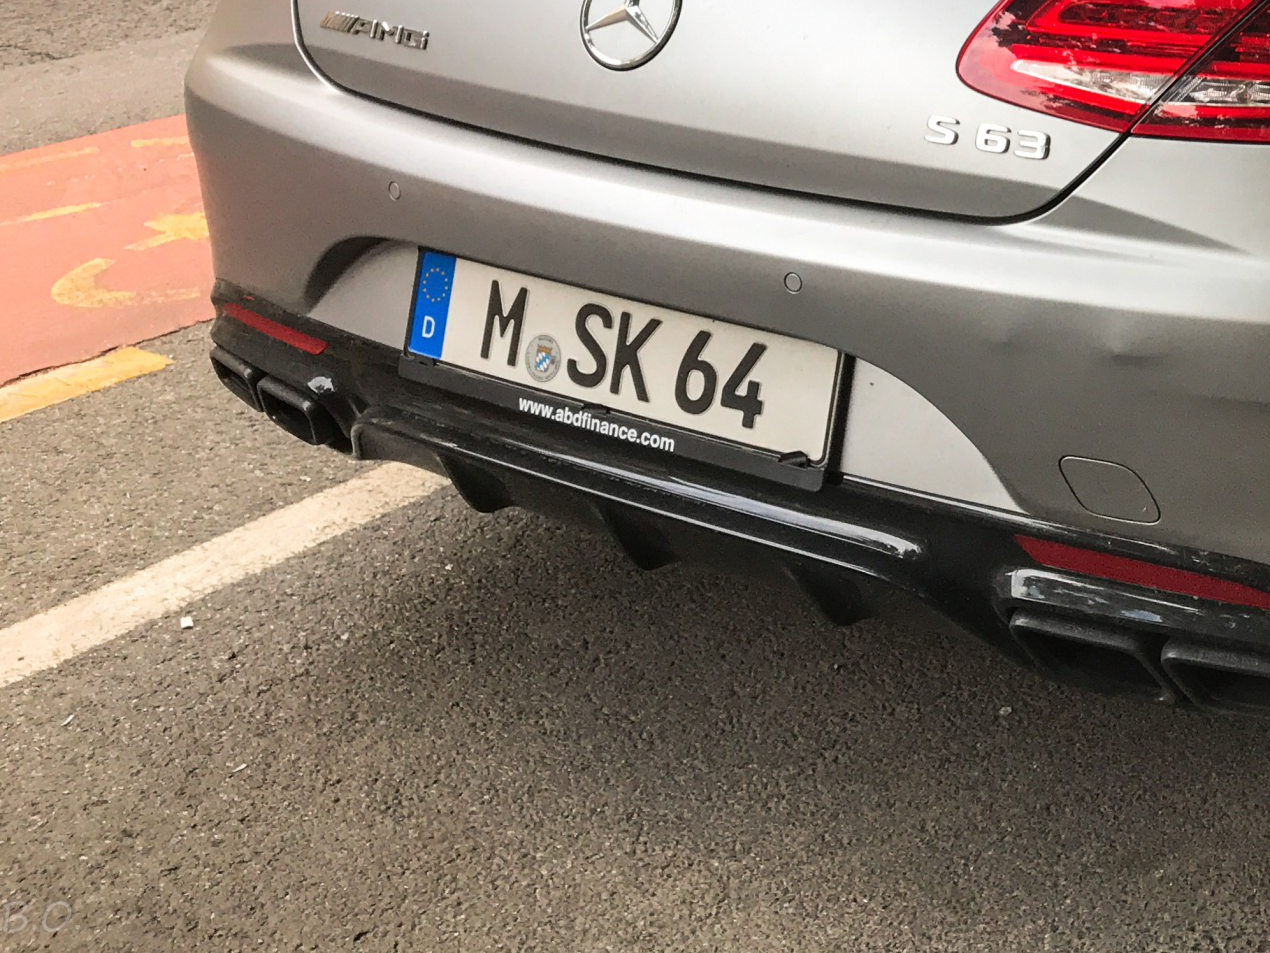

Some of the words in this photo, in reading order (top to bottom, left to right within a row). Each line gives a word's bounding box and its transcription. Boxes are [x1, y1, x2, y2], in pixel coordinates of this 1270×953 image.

[349, 15, 430, 50] AMG
[924, 114, 960, 145] S
[975, 122, 1051, 160] 63
[421, 315, 436, 339] D
[480, 279, 529, 367] M
[567, 303, 663, 403] SK
[674, 330, 768, 429] 64
[518, 397, 675, 453] www.abdfinance.com
